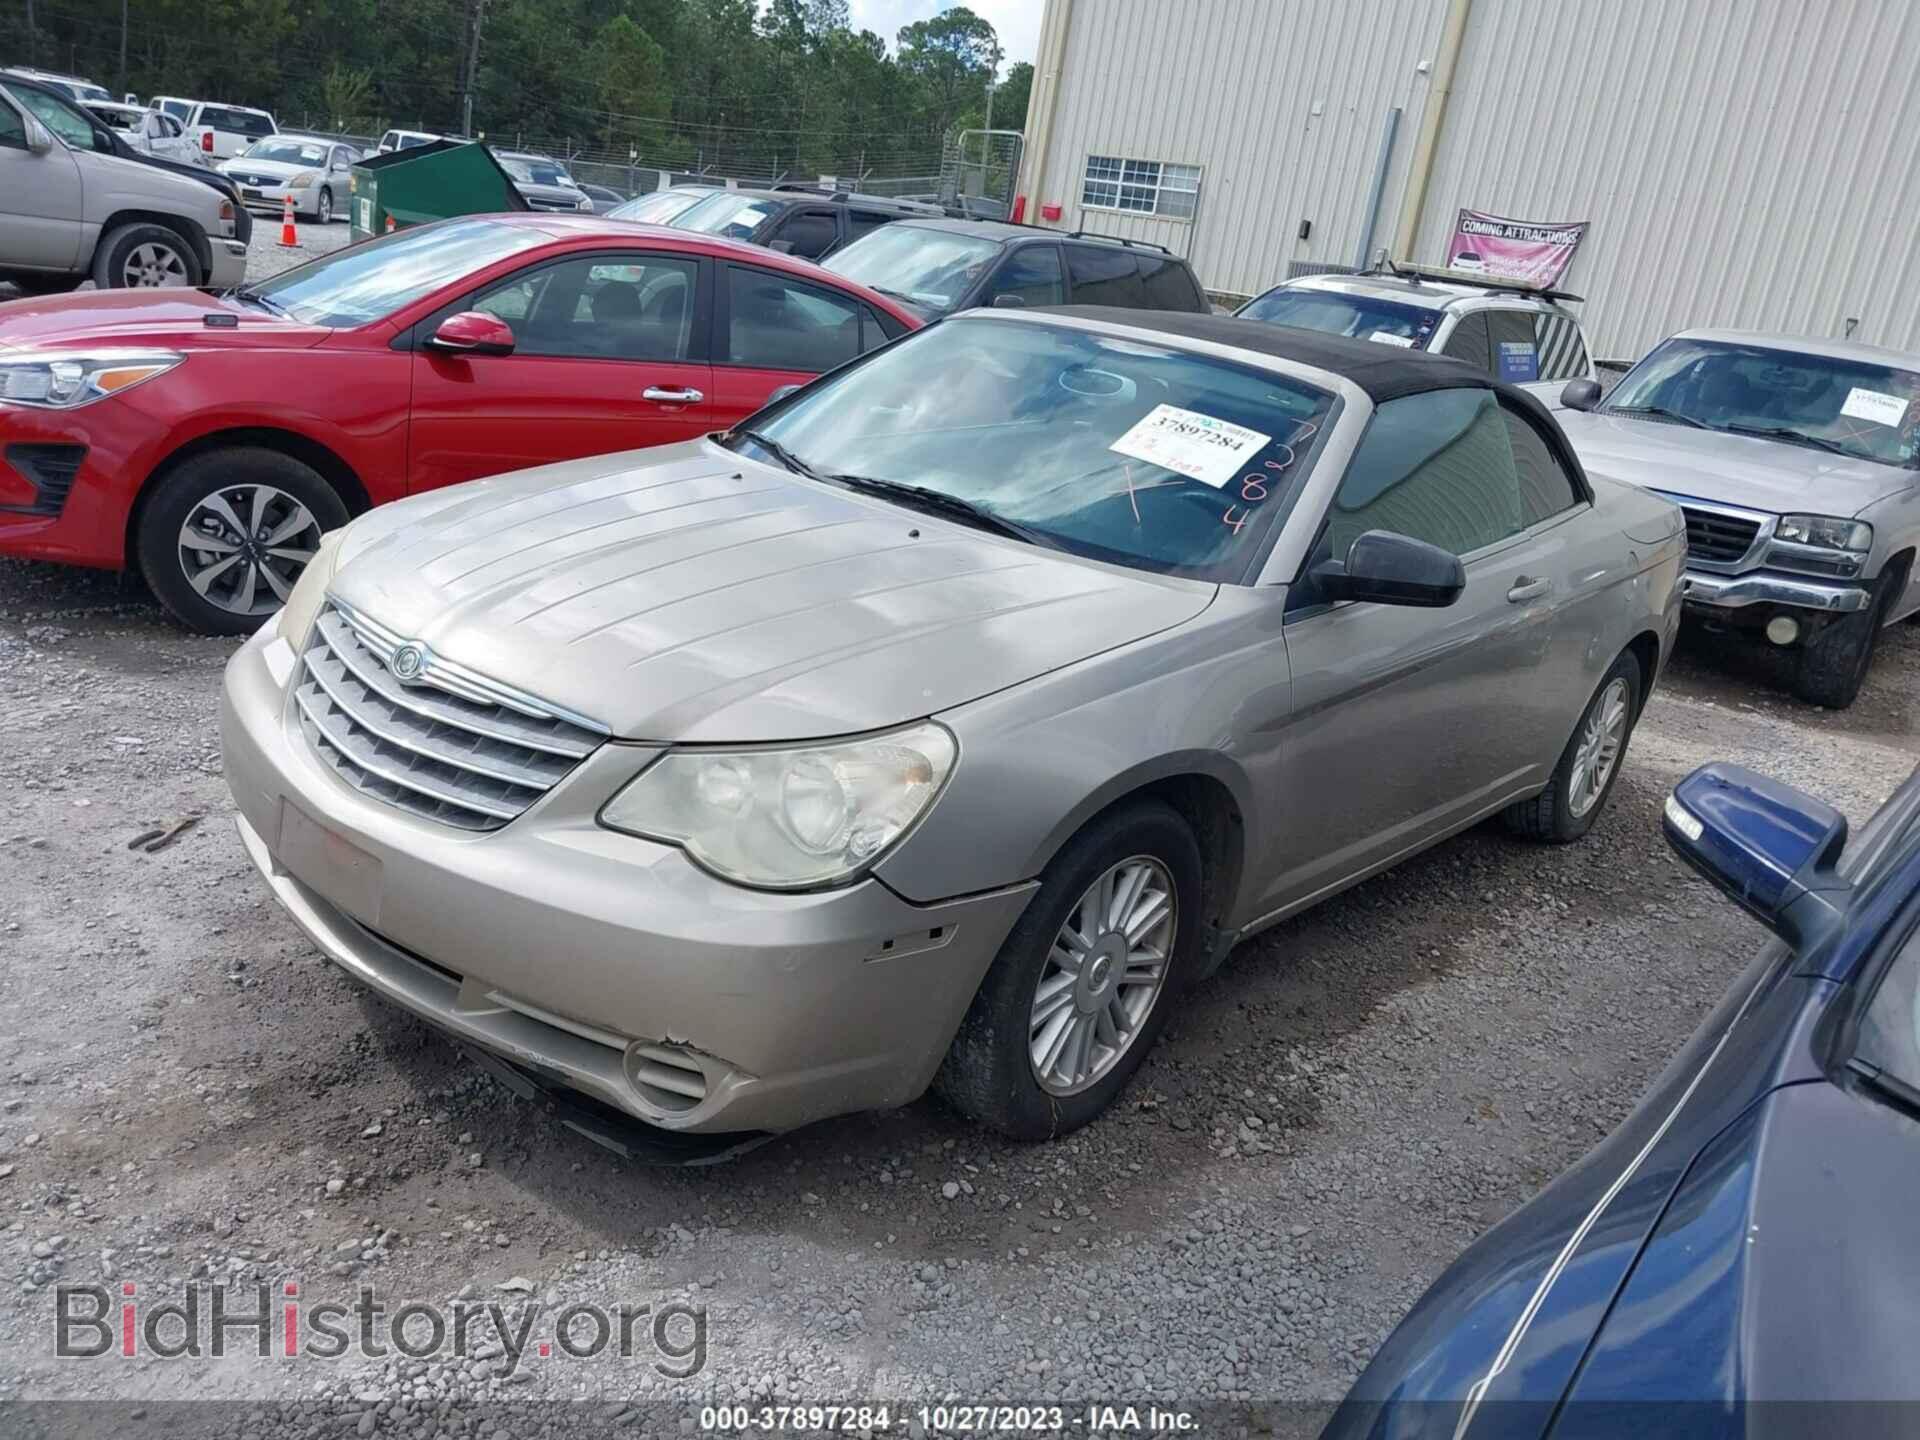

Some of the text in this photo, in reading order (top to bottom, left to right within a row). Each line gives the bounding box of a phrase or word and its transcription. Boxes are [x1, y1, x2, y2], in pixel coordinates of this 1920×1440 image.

[1462, 220, 1578, 245] COMING ATTRACTIONS
[1152, 416, 1244, 451] 37897284
